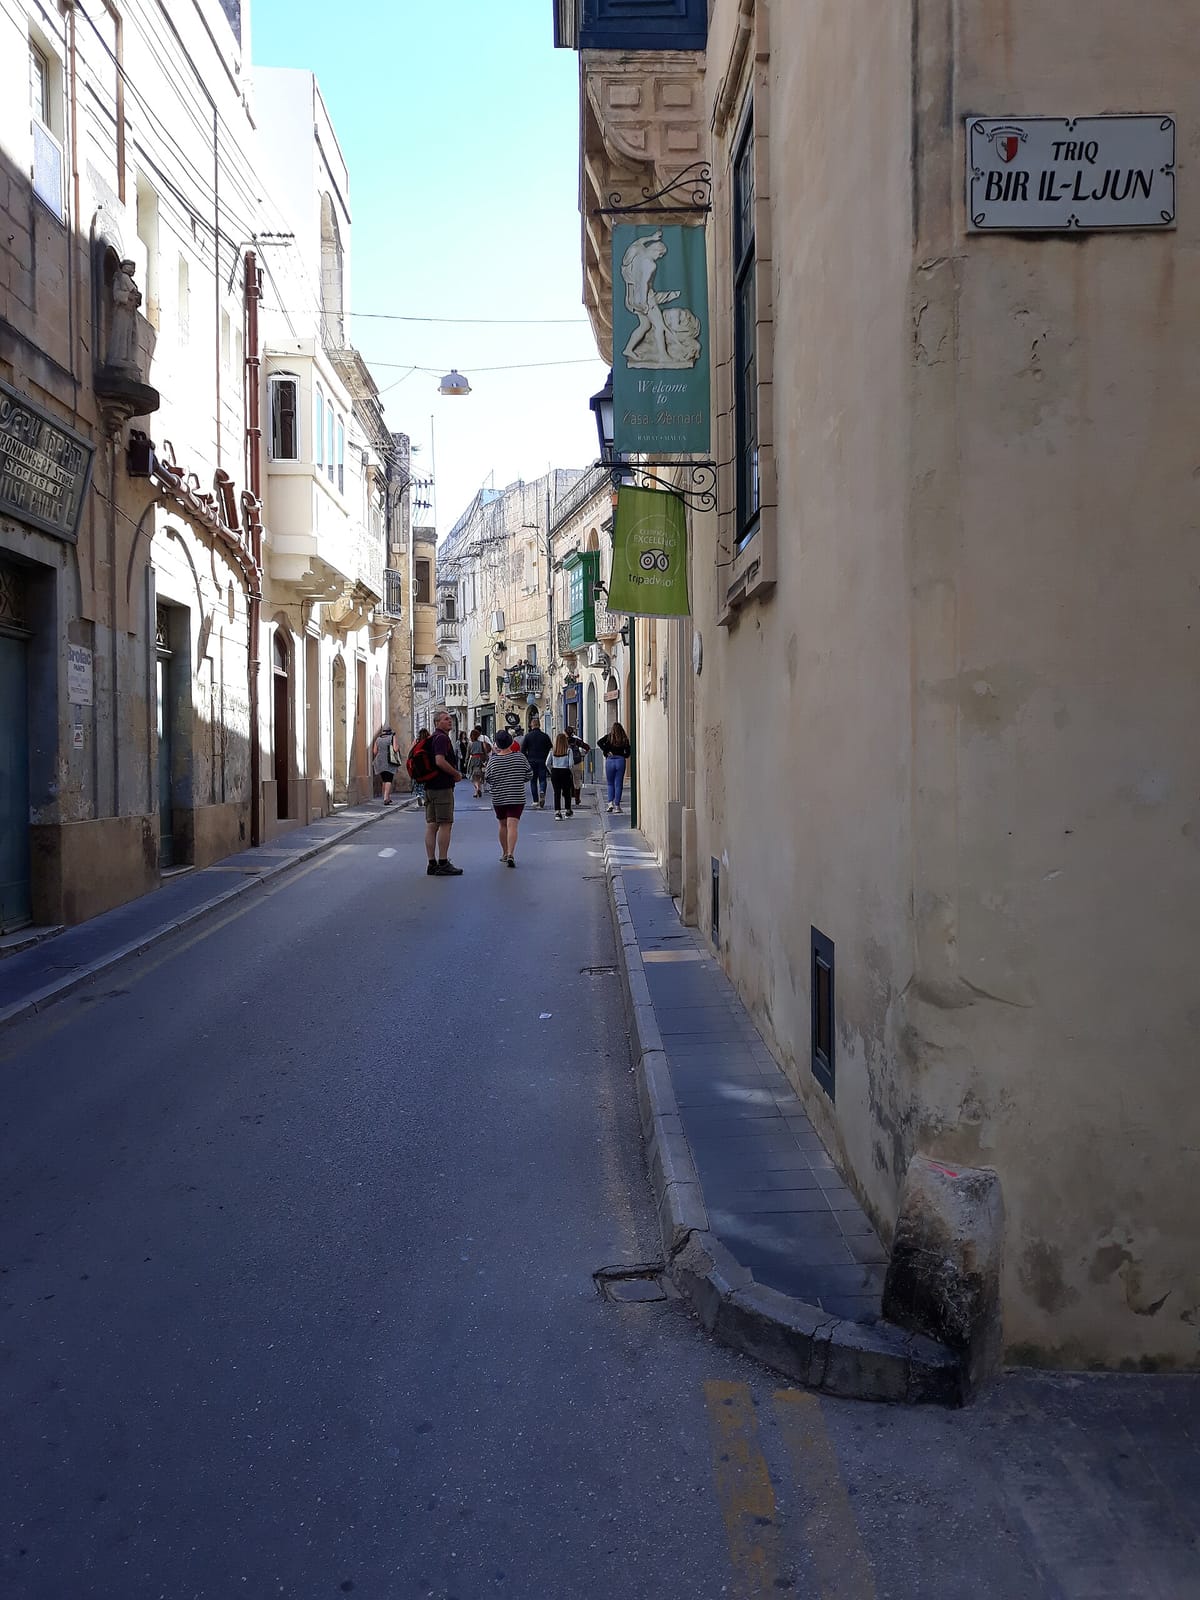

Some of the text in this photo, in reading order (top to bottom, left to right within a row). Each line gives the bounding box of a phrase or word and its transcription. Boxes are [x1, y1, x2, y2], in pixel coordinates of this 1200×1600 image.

[1051, 141, 1100, 164] TRIQ
[984, 169, 1154, 201] BIR IL-LJUN
[638, 380, 688, 393] Welcome
[656, 394, 668, 404] to
[623, 408, 703, 424] Casa Bernard
